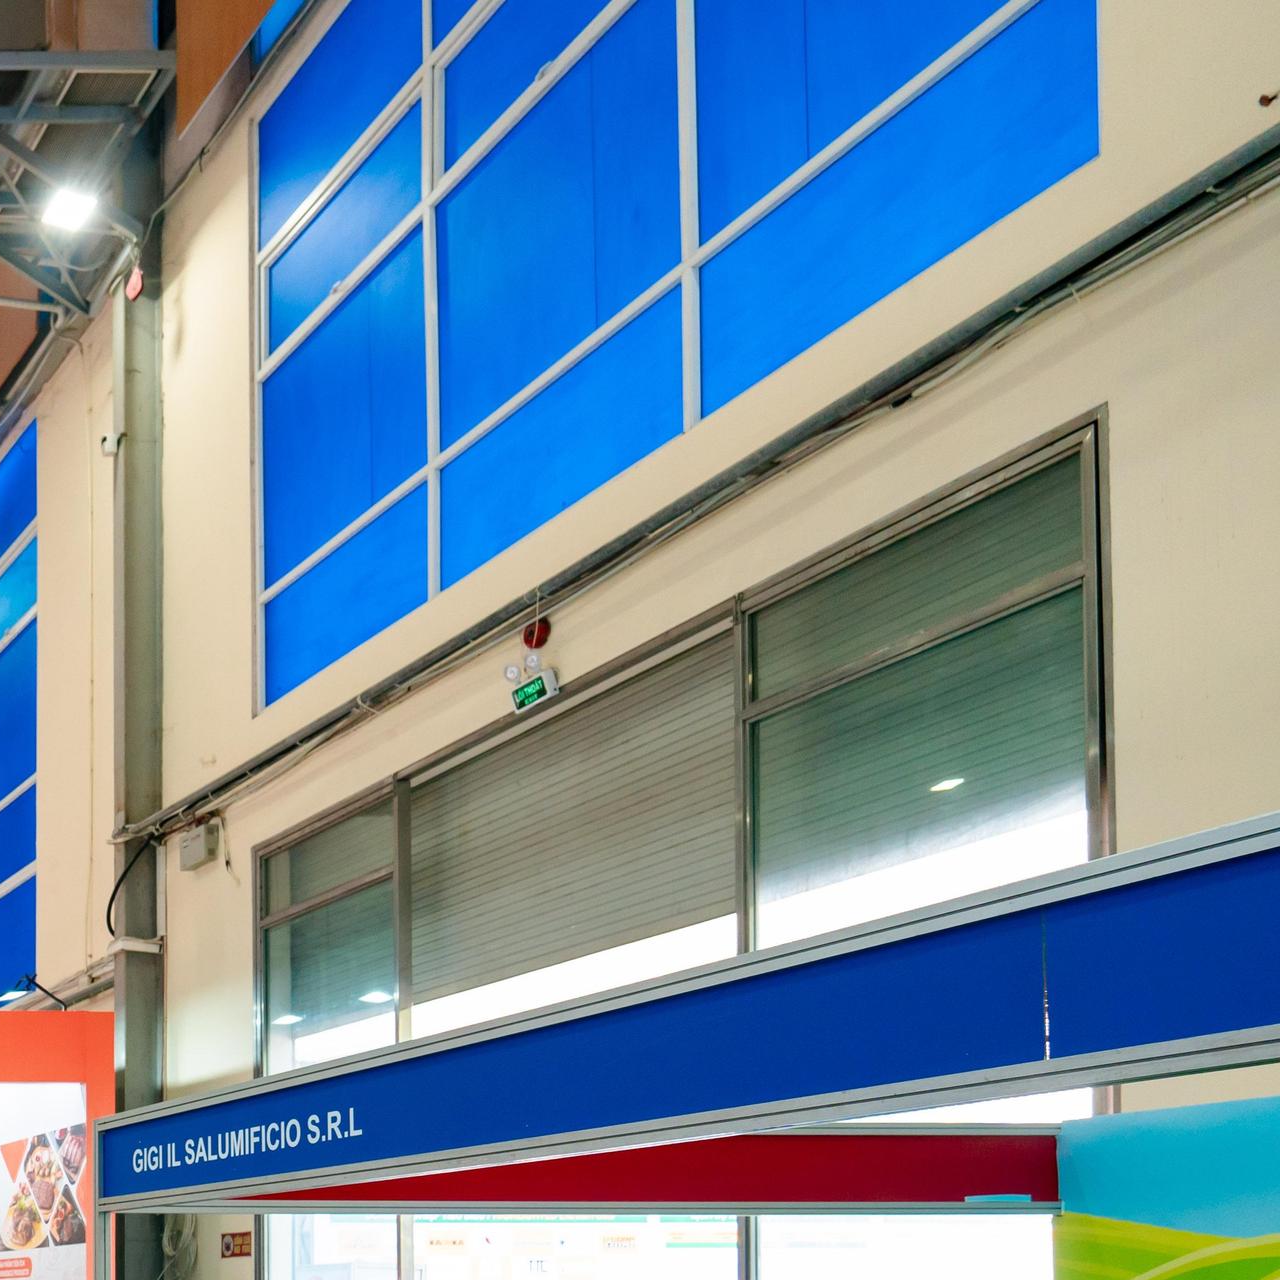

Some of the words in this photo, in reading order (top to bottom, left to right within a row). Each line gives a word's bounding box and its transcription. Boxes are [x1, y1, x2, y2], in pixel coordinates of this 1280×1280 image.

[132, 1143, 163, 1173] GIGI
[167, 1142, 181, 1168] IL
[184, 1118, 302, 1166] SALUMIFICIO
[307, 1107, 363, 1145] S.R.L
